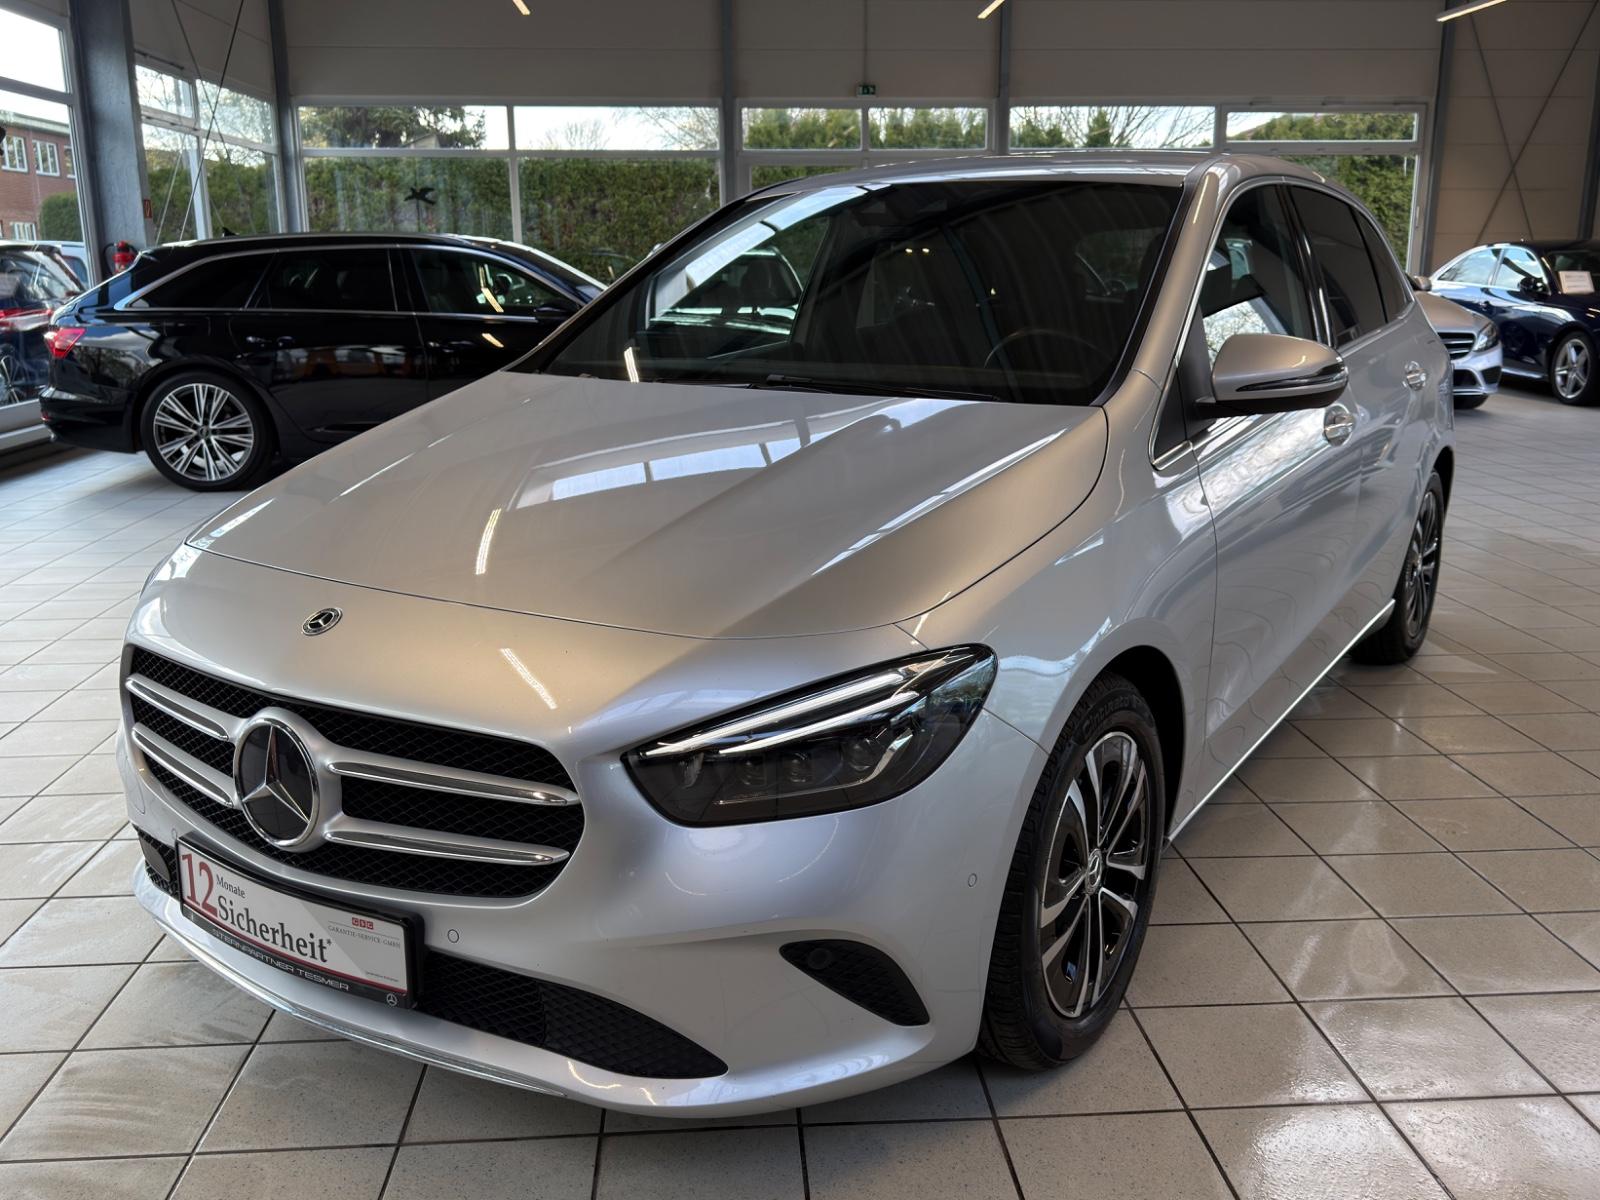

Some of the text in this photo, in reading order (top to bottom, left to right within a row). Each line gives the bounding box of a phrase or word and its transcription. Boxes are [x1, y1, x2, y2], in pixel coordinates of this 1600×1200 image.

[182, 853, 218, 919] 12
[216, 874, 246, 899] Monate
[297, 968, 349, 991] TESMER
